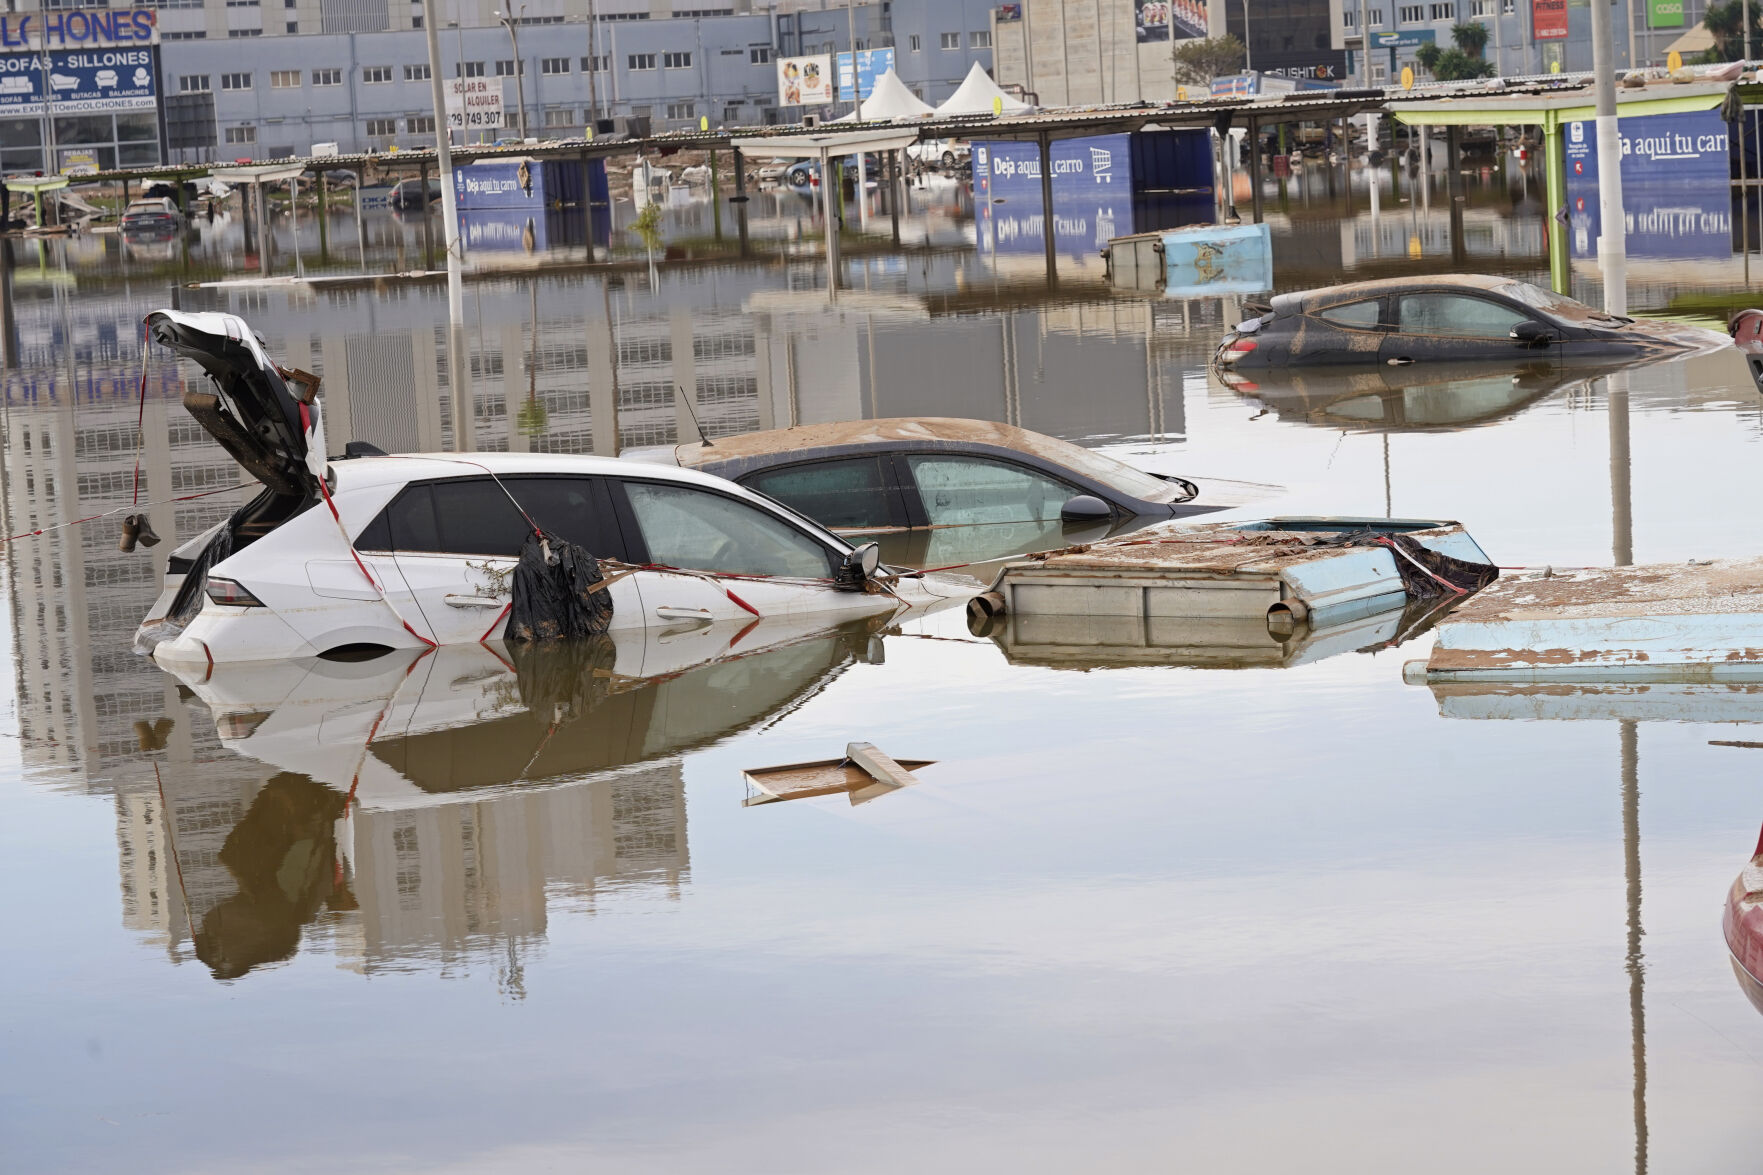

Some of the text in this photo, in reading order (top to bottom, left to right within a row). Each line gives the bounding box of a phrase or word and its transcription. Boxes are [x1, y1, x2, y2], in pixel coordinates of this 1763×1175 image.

[68, 51, 149, 68] SILLONES
[109, 88, 150, 97] BALANCINES
[478, 82, 487, 92] EN
[71, 91, 102, 100] BUTACAS
[467, 95, 500, 106] ALQUILER
[484, 111, 501, 125] 307
[1635, 132, 1672, 160] aquí
[1674, 134, 1693, 153] tu
[994, 156, 1016, 179] Deja
[1017, 156, 1040, 178] aquí
[1055, 159, 1084, 173] carro
[466, 178, 480, 196] Deja
[480, 177, 493, 194] aquí
[493, 179, 500, 191] tu
[501, 180, 518, 191] carro
